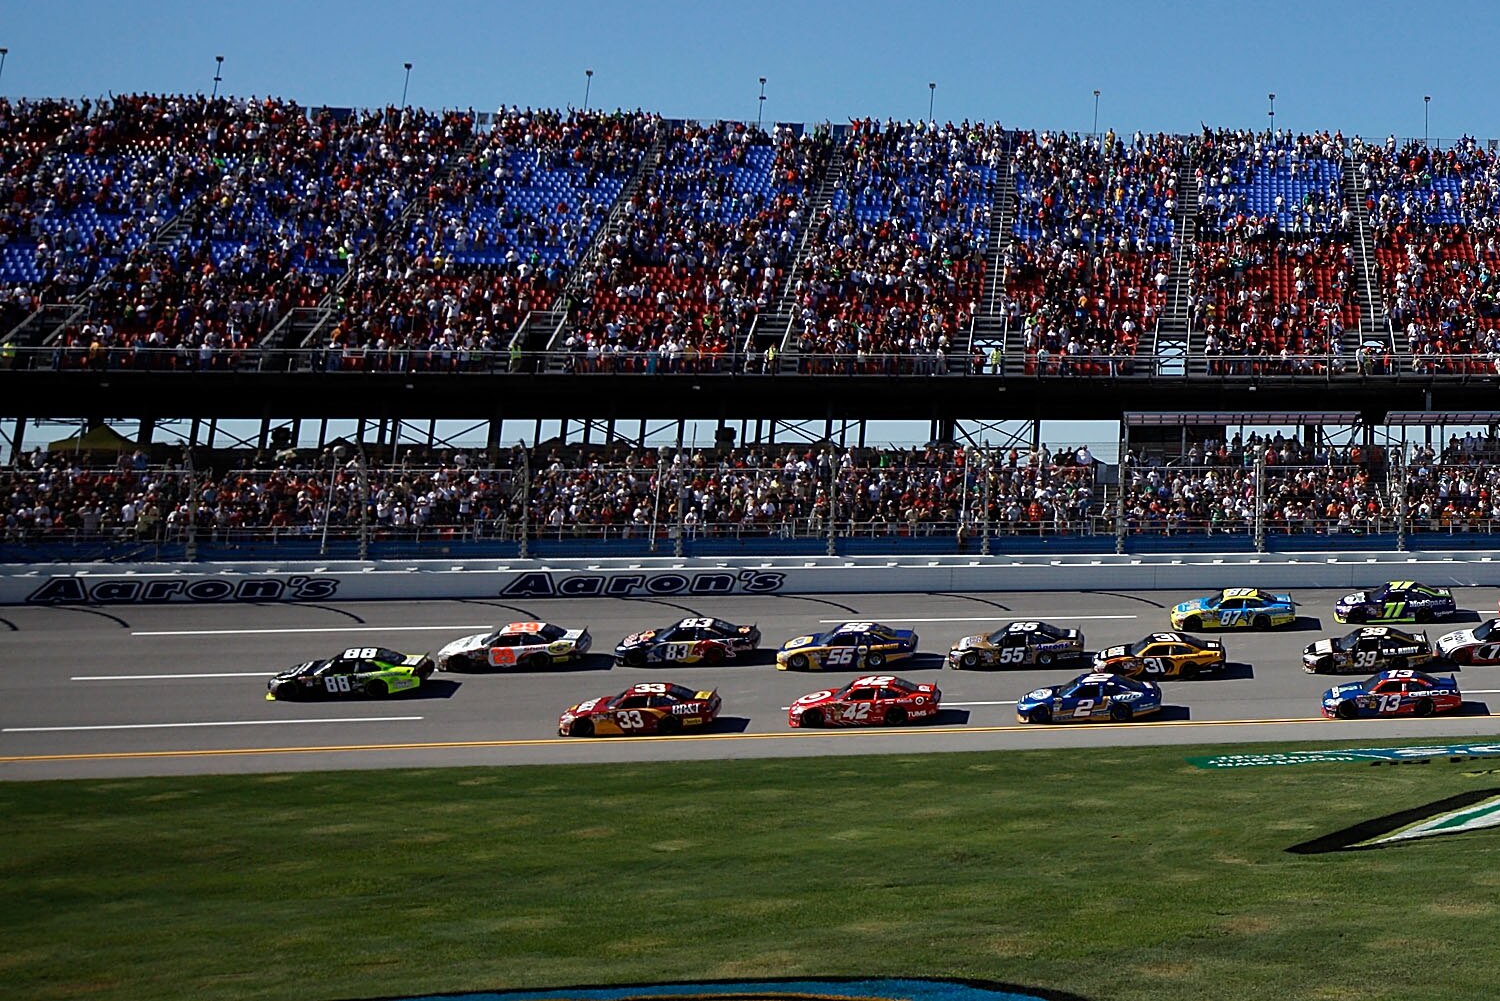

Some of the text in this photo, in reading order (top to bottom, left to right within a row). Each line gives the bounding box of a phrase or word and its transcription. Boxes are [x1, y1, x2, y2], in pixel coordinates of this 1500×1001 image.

[26, 576, 340, 603] Aaron's
[500, 570, 786, 597] Aaron's
[1383, 601, 1406, 618] 71
[1409, 599, 1446, 608] ModSpace
[680, 618, 714, 628] 83
[1220, 610, 1242, 626] 87
[510, 622, 538, 632] 29
[842, 623, 872, 632] 56
[1009, 622, 1039, 631] 55
[1360, 627, 1388, 636] 39
[1153, 633, 1182, 642] 31
[343, 648, 378, 659] 88
[666, 644, 689, 660] 83
[826, 648, 854, 665] 56
[1000, 647, 1025, 663] 55
[1382, 646, 1419, 656] U.S. ARMY
[1143, 658, 1166, 672] 31
[1354, 651, 1377, 667] 39
[854, 676, 895, 685] 42
[1082, 673, 1114, 683] 2
[1387, 670, 1414, 678] 13
[325, 676, 351, 693] 88
[635, 684, 666, 692] 33
[672, 702, 700, 714] BB&T
[1073, 699, 1094, 717] 2
[1378, 695, 1402, 712] 13
[843, 702, 871, 719] 42
[617, 711, 644, 728] 33
